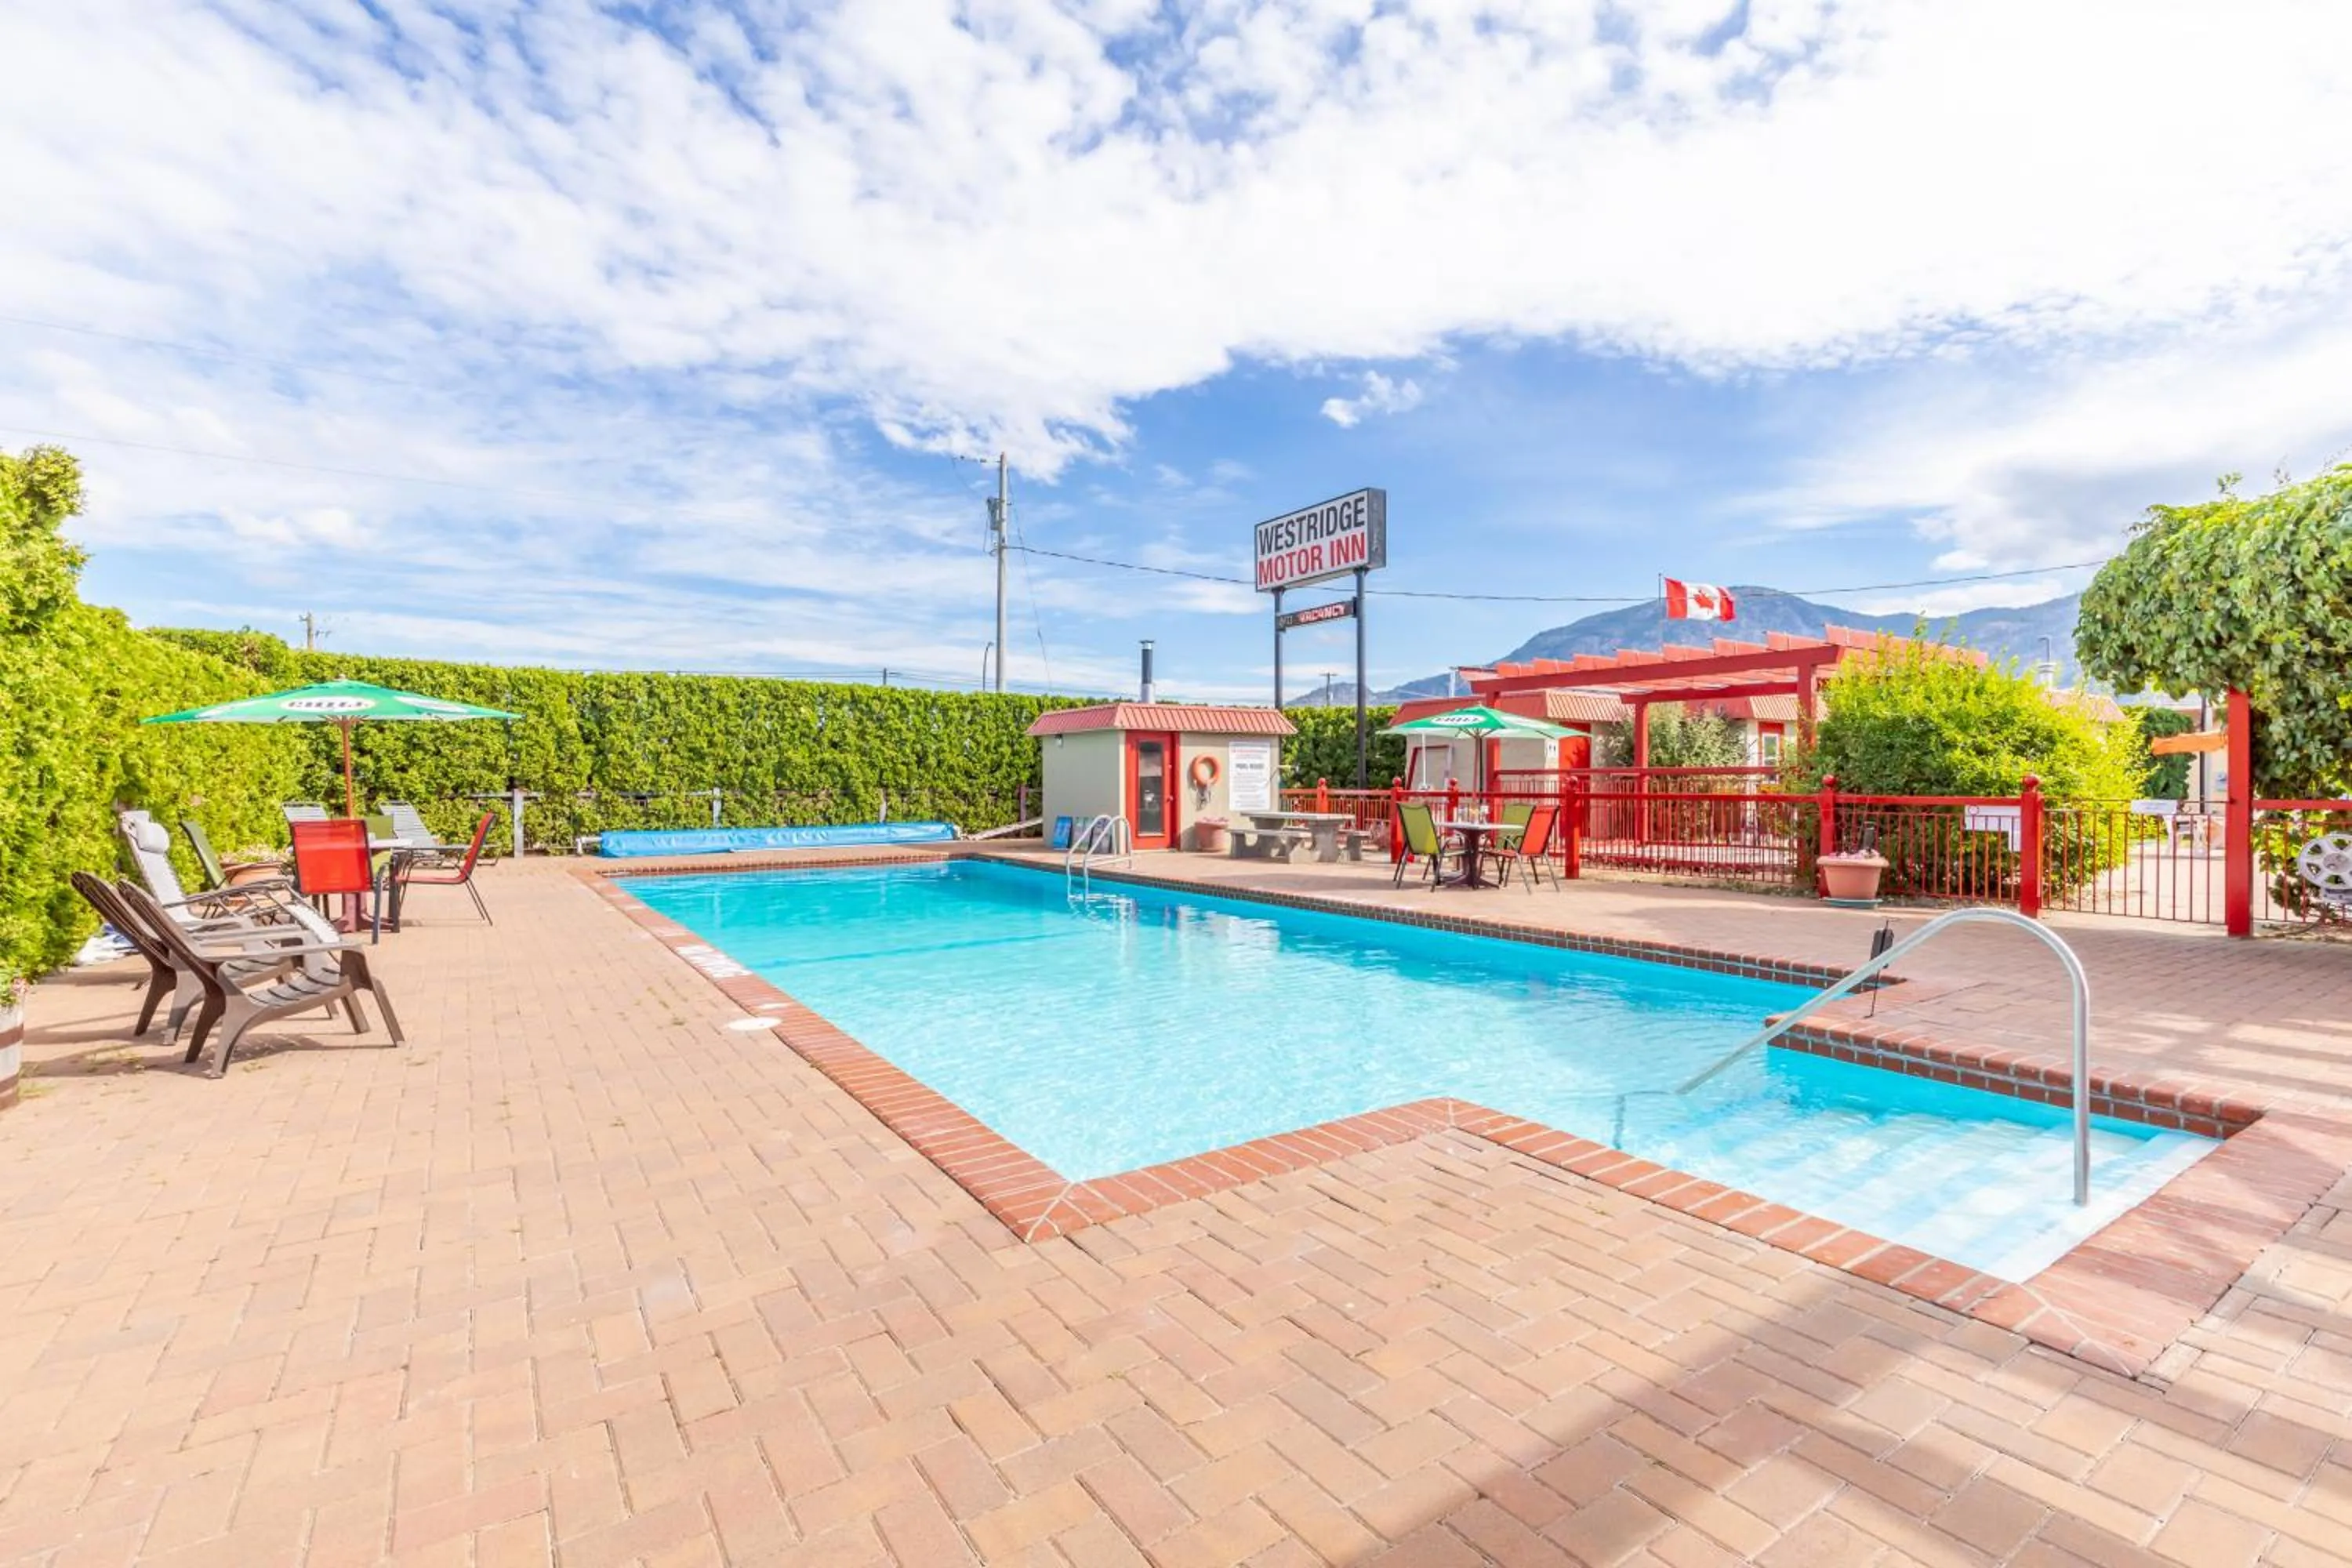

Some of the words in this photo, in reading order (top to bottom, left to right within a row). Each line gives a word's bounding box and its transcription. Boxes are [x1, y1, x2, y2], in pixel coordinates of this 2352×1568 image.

[1259, 497, 1365, 555] WESTRIDGE
[1259, 545, 1323, 585] MOTOR
[1330, 532, 1365, 566] INN
[1299, 604, 1345, 622] VACANCY
